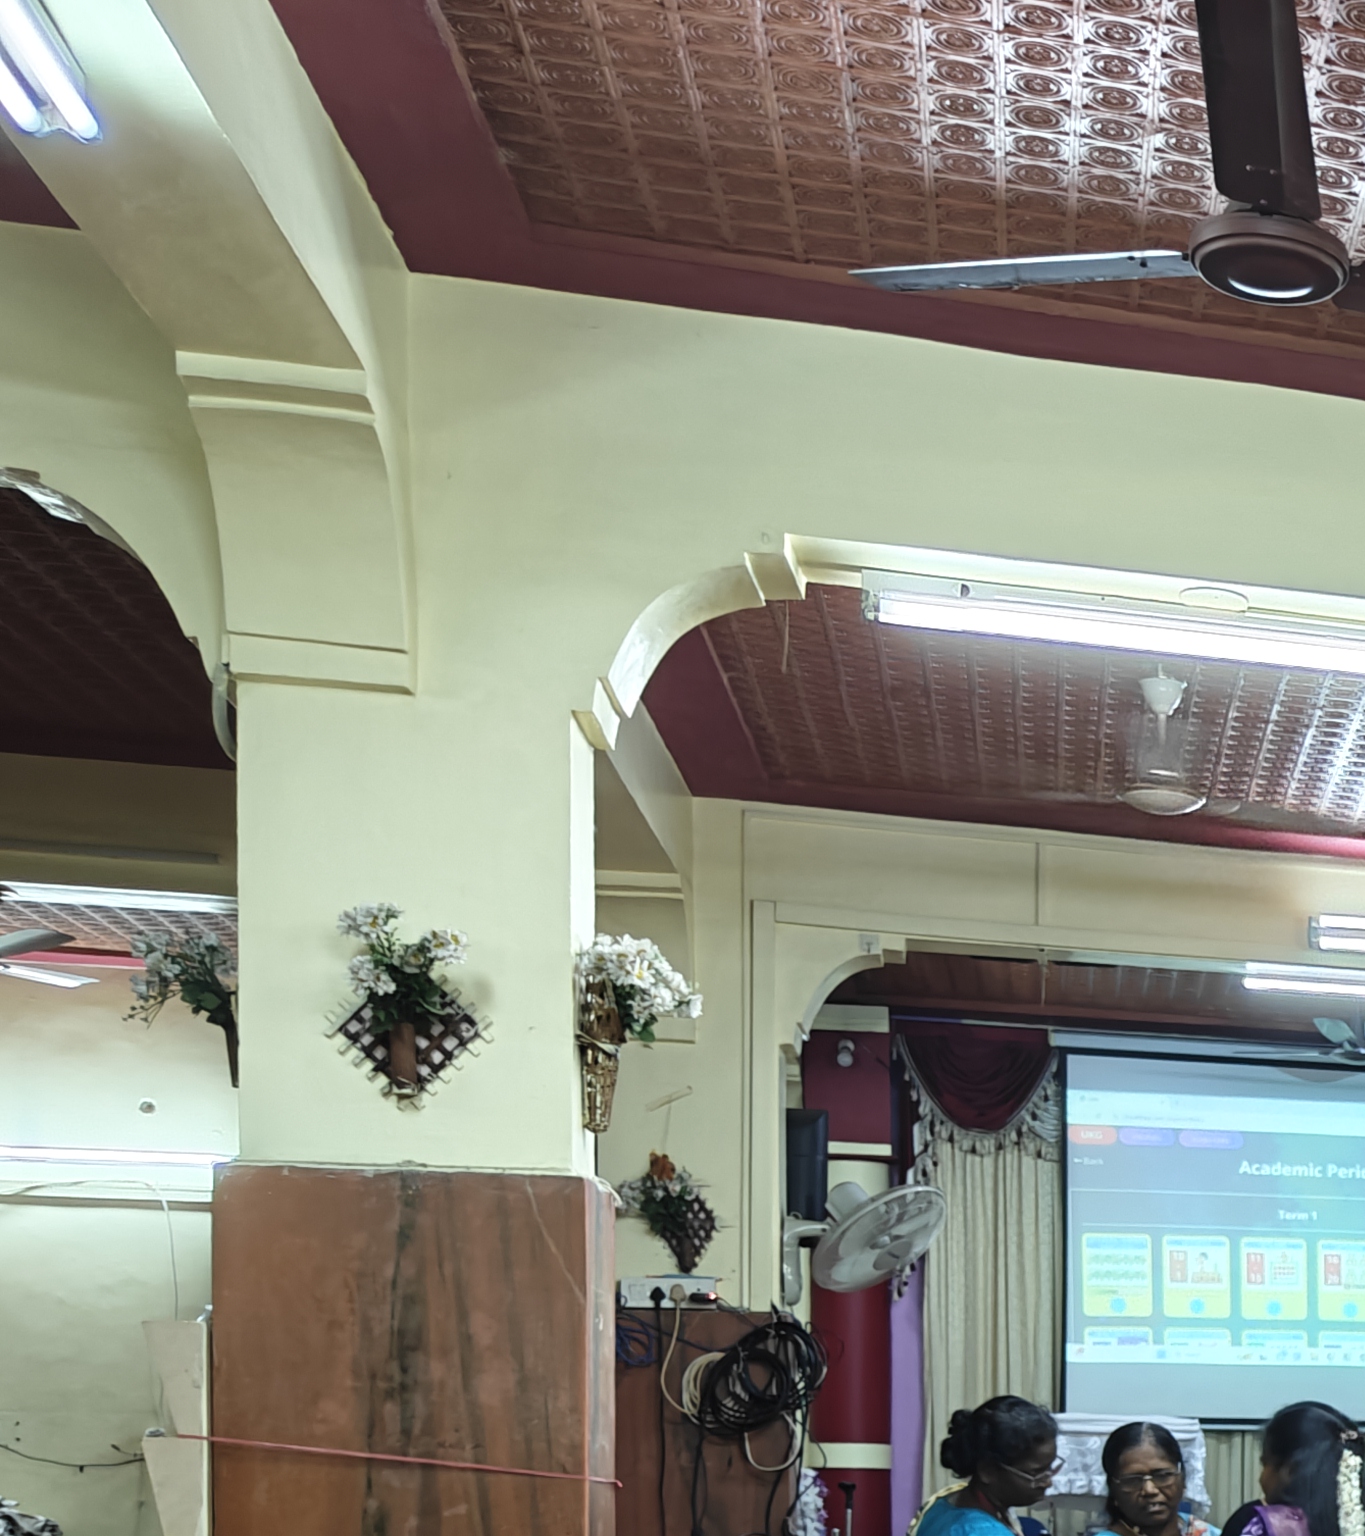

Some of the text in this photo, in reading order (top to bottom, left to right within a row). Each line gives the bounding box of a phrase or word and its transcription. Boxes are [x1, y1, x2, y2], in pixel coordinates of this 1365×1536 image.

[1238, 1160, 1323, 1178] Academic
[1278, 1209, 1318, 1221] Term 1
